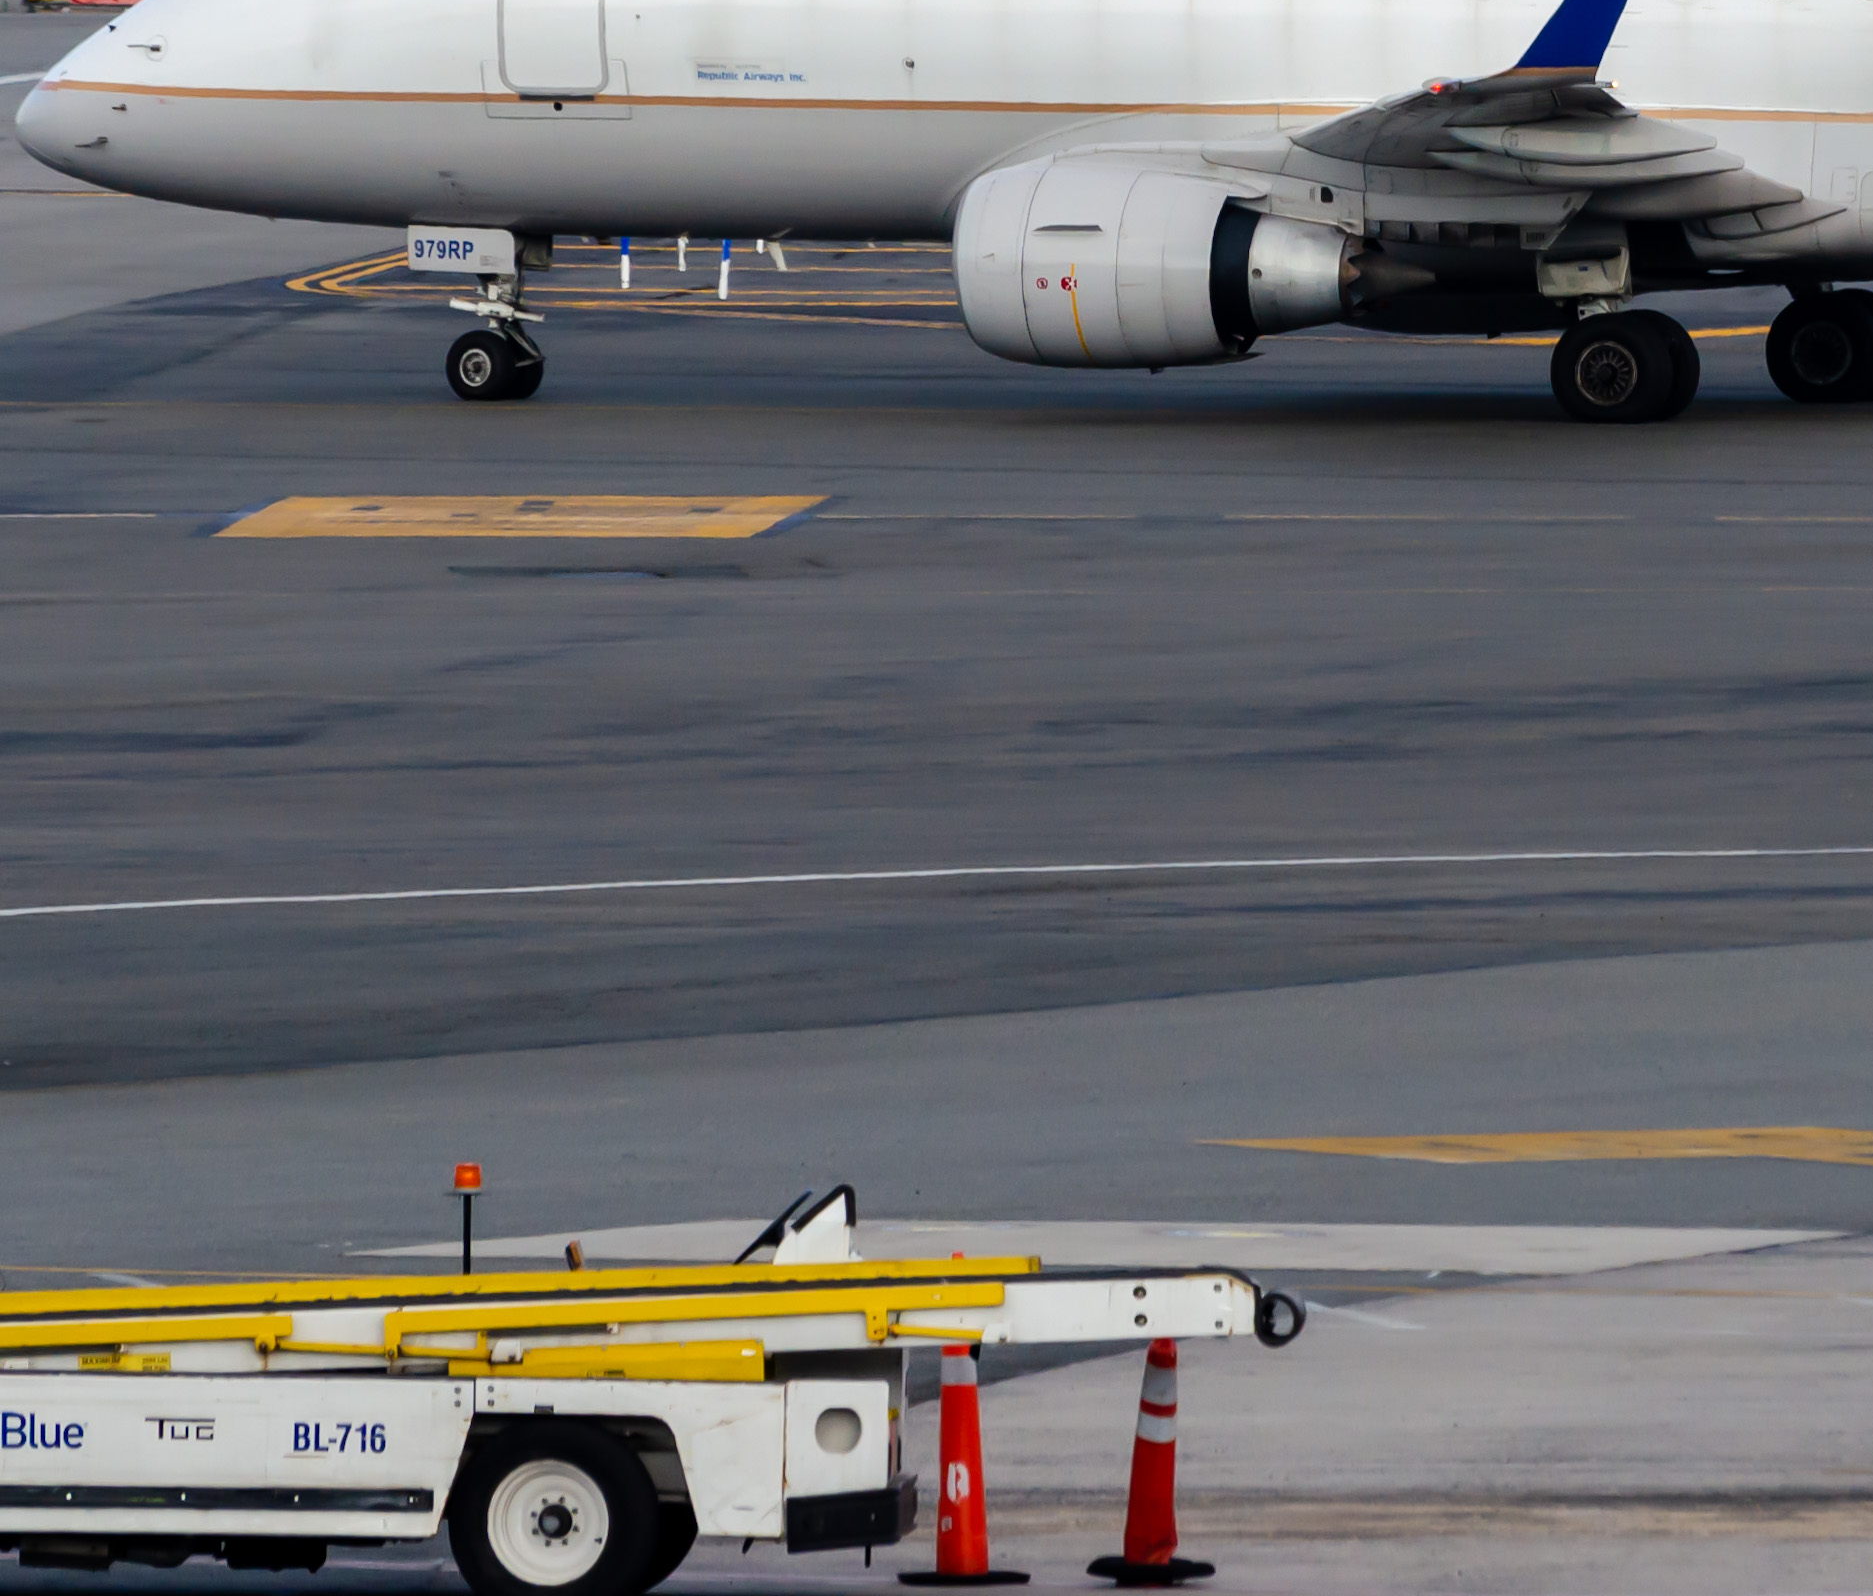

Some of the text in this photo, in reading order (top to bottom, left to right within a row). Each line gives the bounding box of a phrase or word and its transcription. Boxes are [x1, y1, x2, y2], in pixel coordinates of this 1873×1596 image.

[697, 70, 807, 83] Republic Airways Inc.
[414, 239, 475, 260] 979RP
[1, 1412, 85, 1449] Blue
[293, 1422, 387, 1453] BL-716
